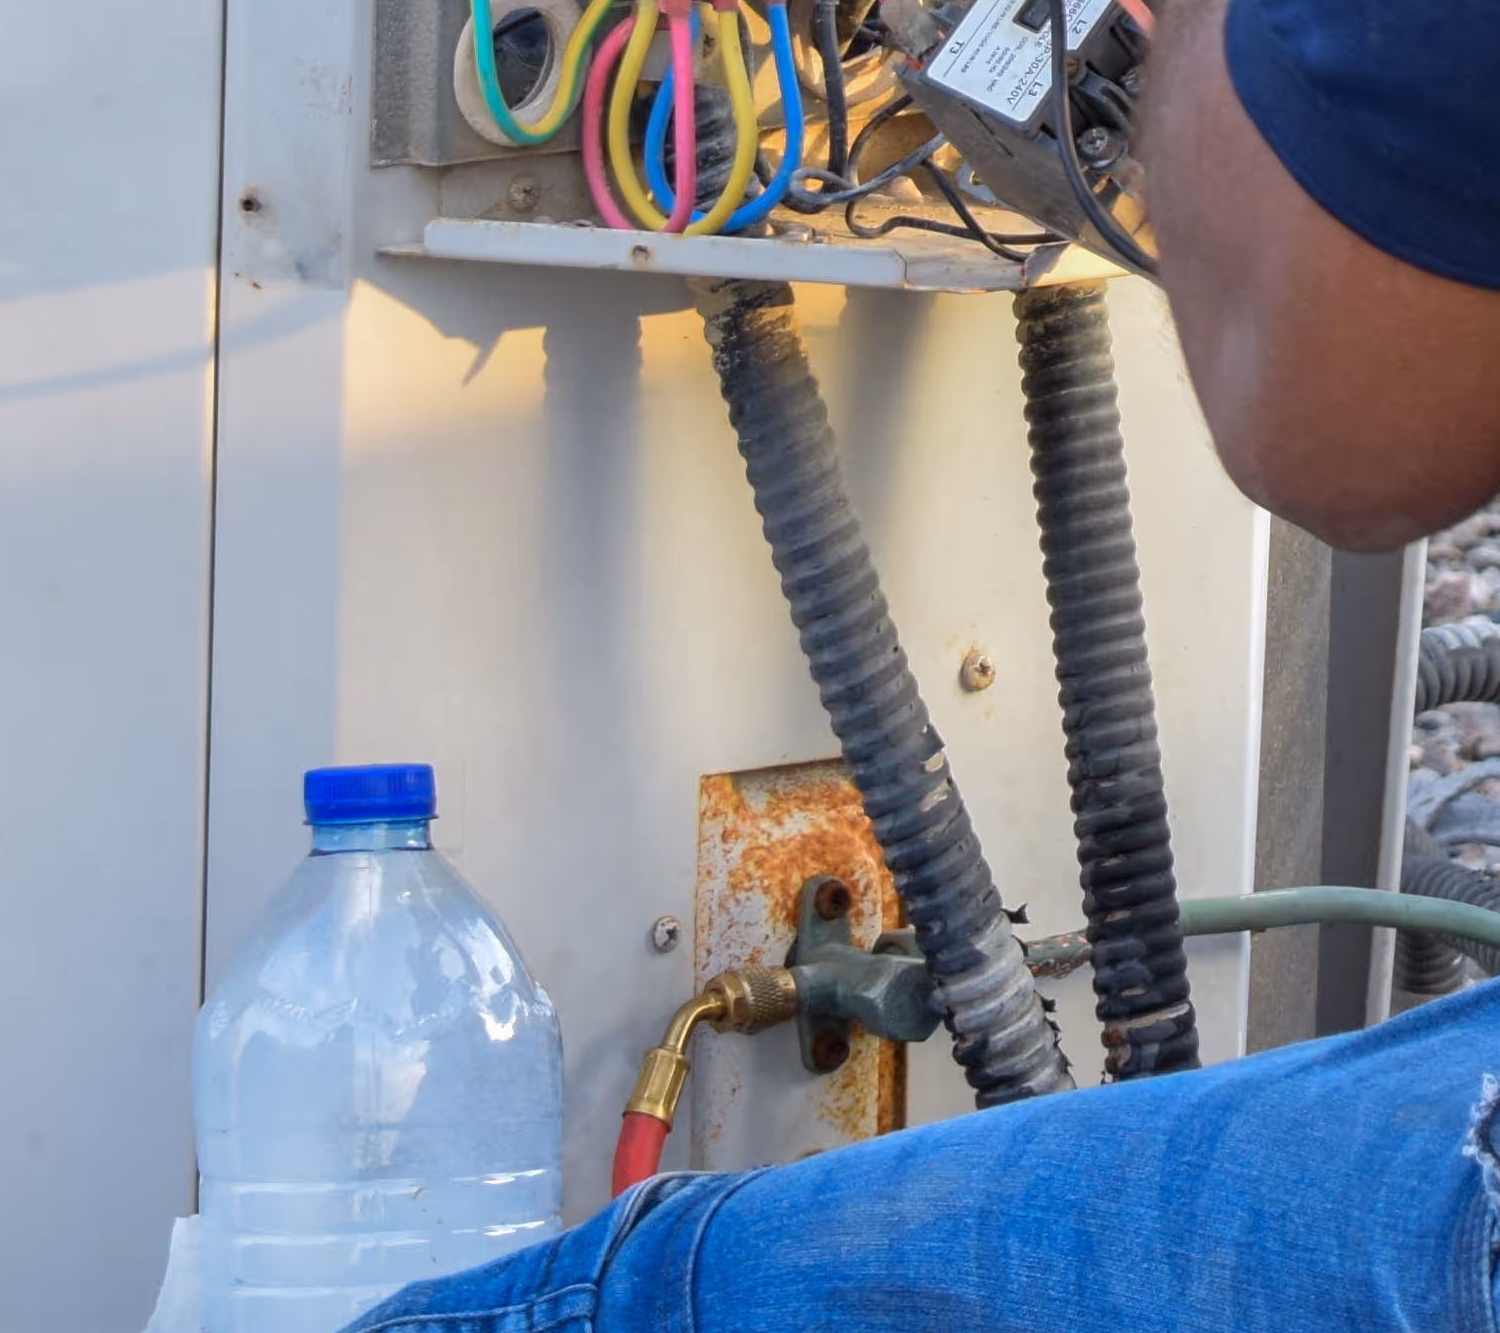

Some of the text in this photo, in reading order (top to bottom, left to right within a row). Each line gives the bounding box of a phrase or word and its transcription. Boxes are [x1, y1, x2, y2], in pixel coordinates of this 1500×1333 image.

[1071, 17, 1087, 35] L2
[948, 38, 964, 56] T3
[1026, 80, 1043, 98] L3
